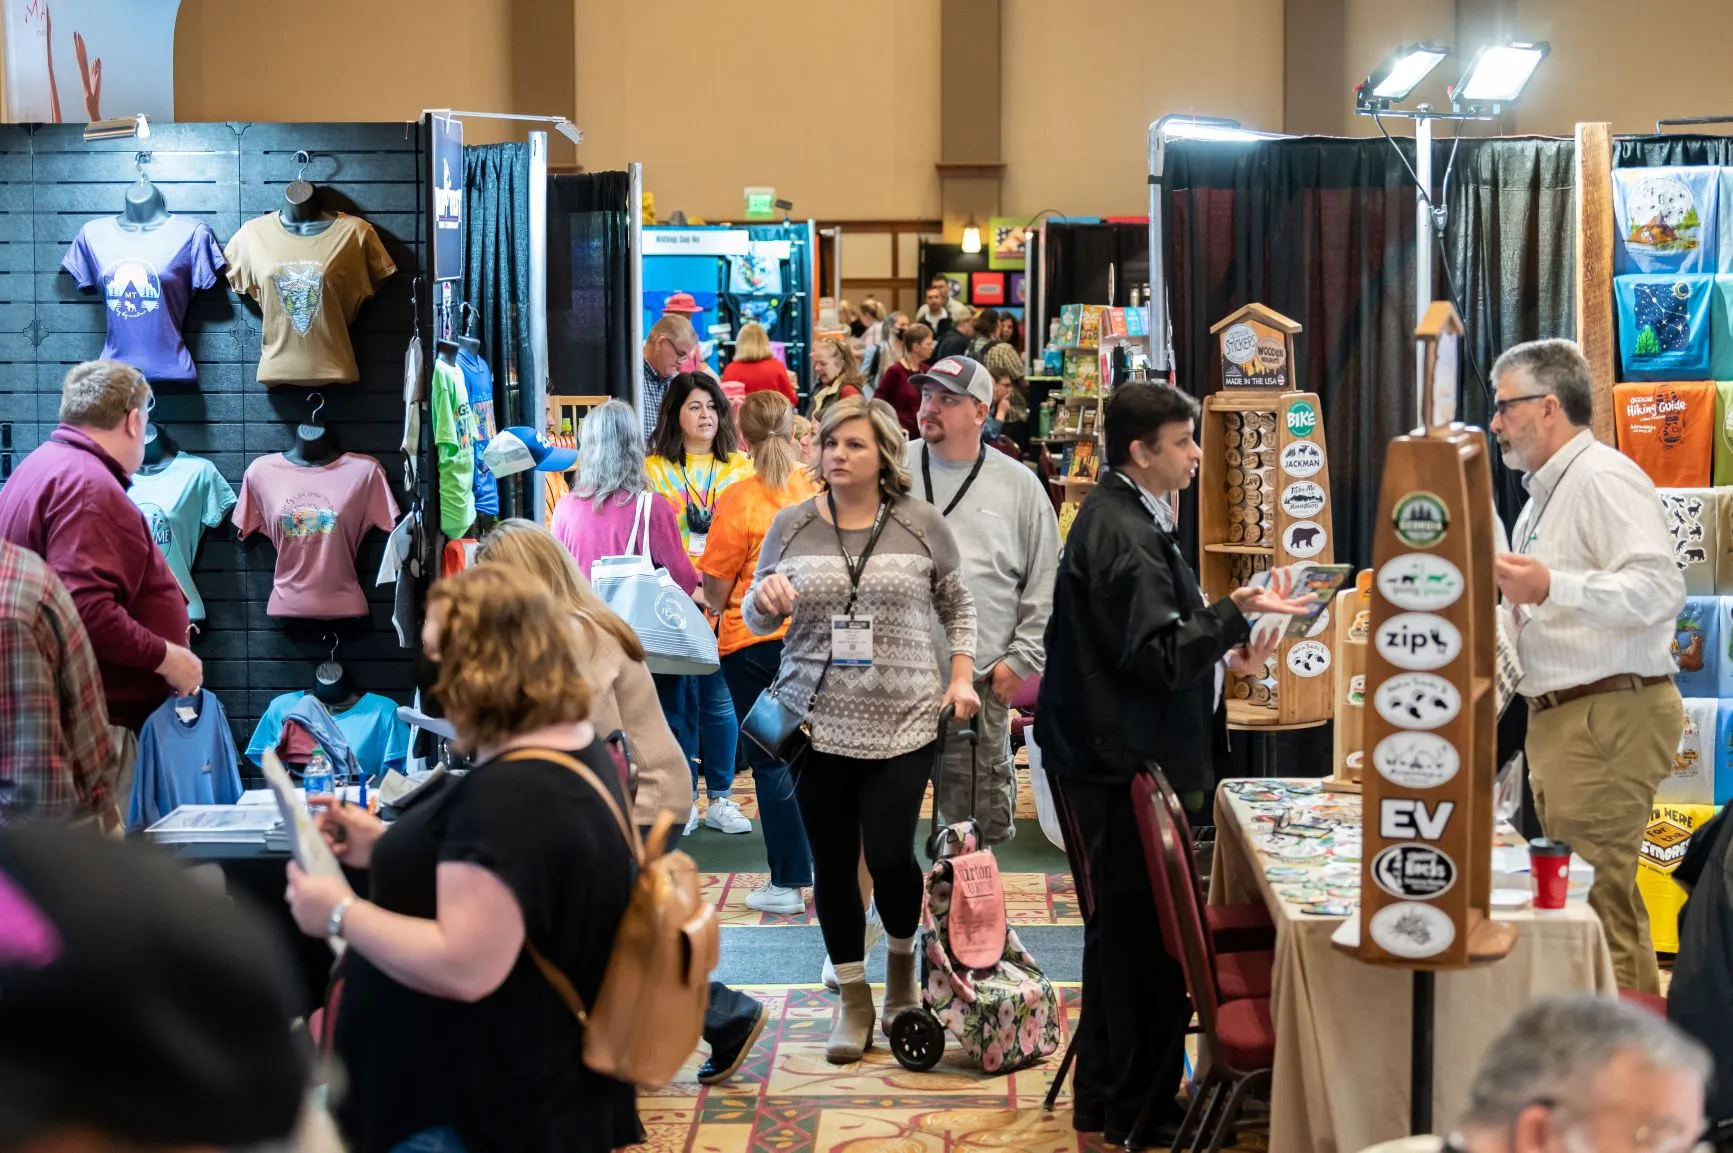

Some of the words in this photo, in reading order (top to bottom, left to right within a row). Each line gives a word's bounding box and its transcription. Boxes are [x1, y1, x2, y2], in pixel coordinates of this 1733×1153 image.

[1226, 377, 1243, 385] MADE
[1244, 377, 1251, 385] IN
[1252, 377, 1264, 385] THE
[1264, 377, 1277, 385] USA
[1627, 402, 1657, 417] Hiking
[1287, 410, 1316, 428] BIKE
[1285, 459, 1321, 468] JACKMAN
[1386, 624, 1427, 654] zip
[1380, 798, 1456, 840] EV
